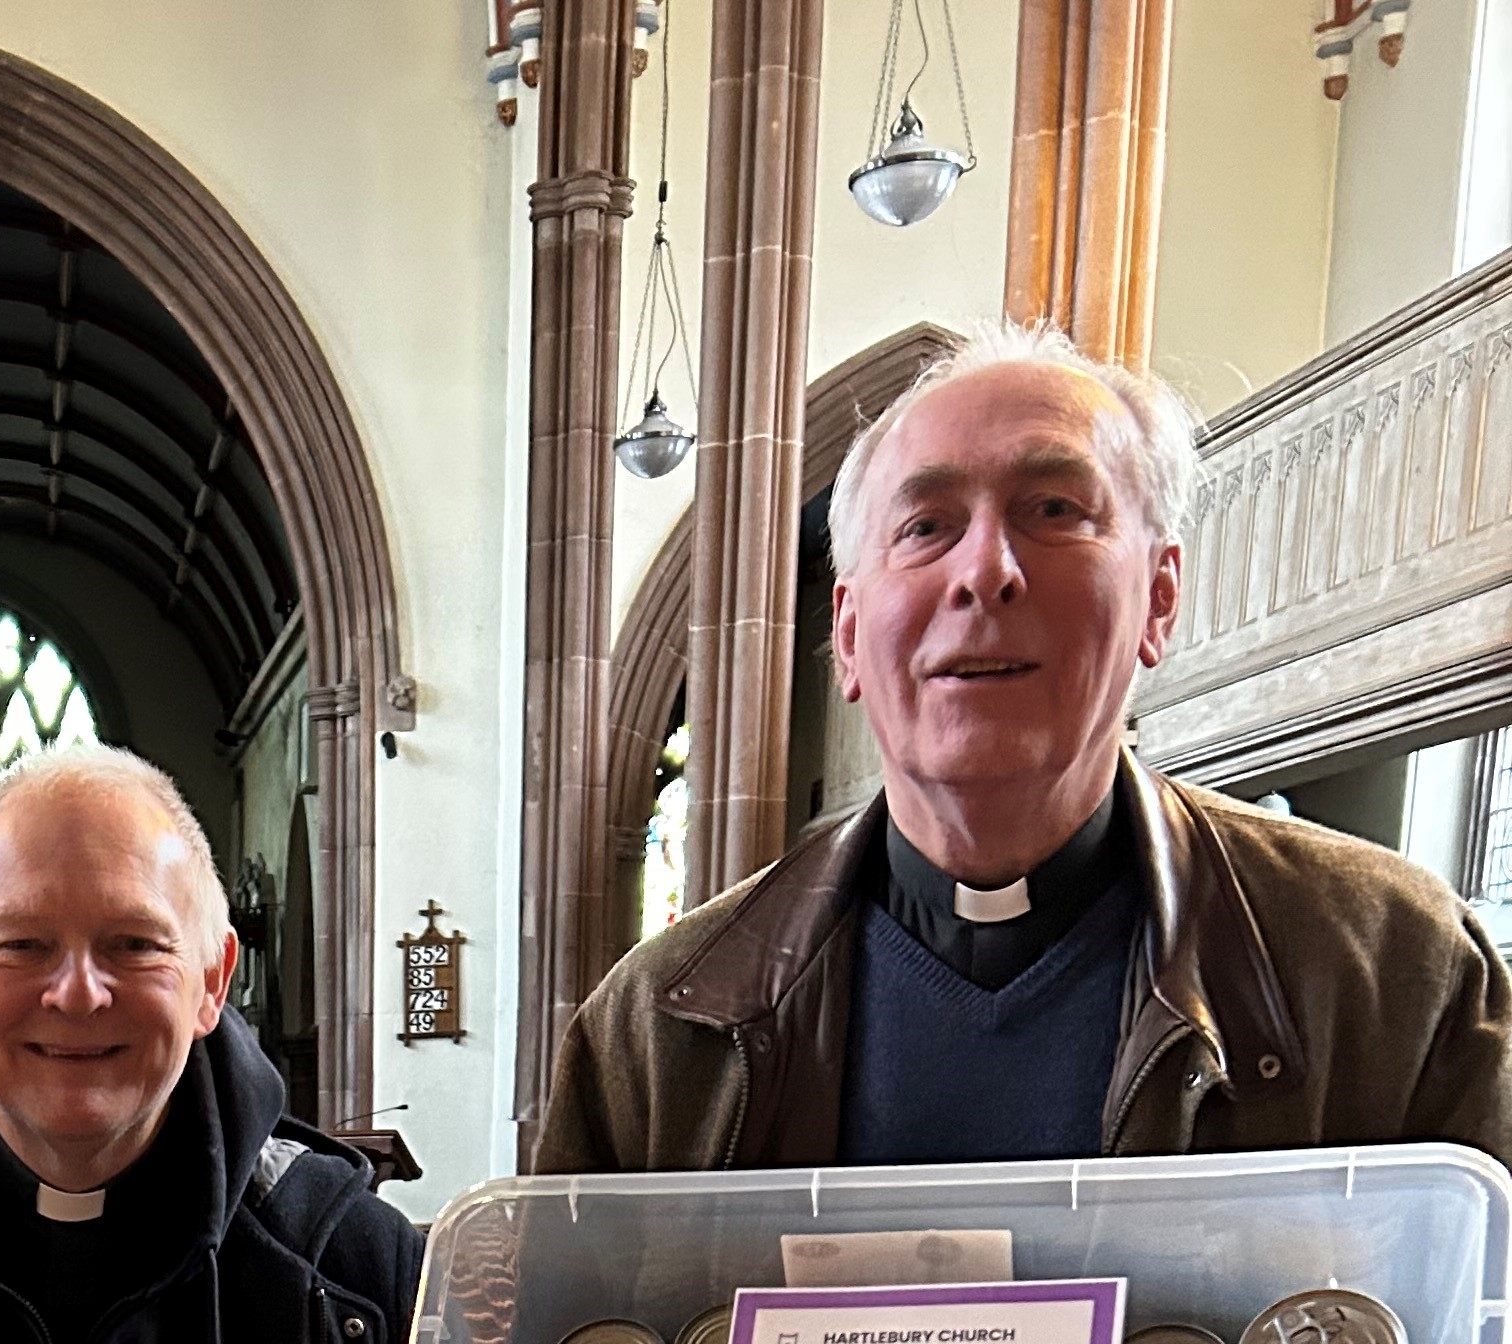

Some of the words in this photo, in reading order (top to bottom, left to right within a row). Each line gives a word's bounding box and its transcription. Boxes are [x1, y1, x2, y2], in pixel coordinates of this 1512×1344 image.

[410, 945, 446, 964] 552
[409, 968, 433, 987] 85
[410, 990, 447, 1010] 724
[409, 1013, 434, 1031] 49
[823, 1330, 934, 1344] HARTLEBURY
[938, 1328, 1016, 1343] CHURCH
